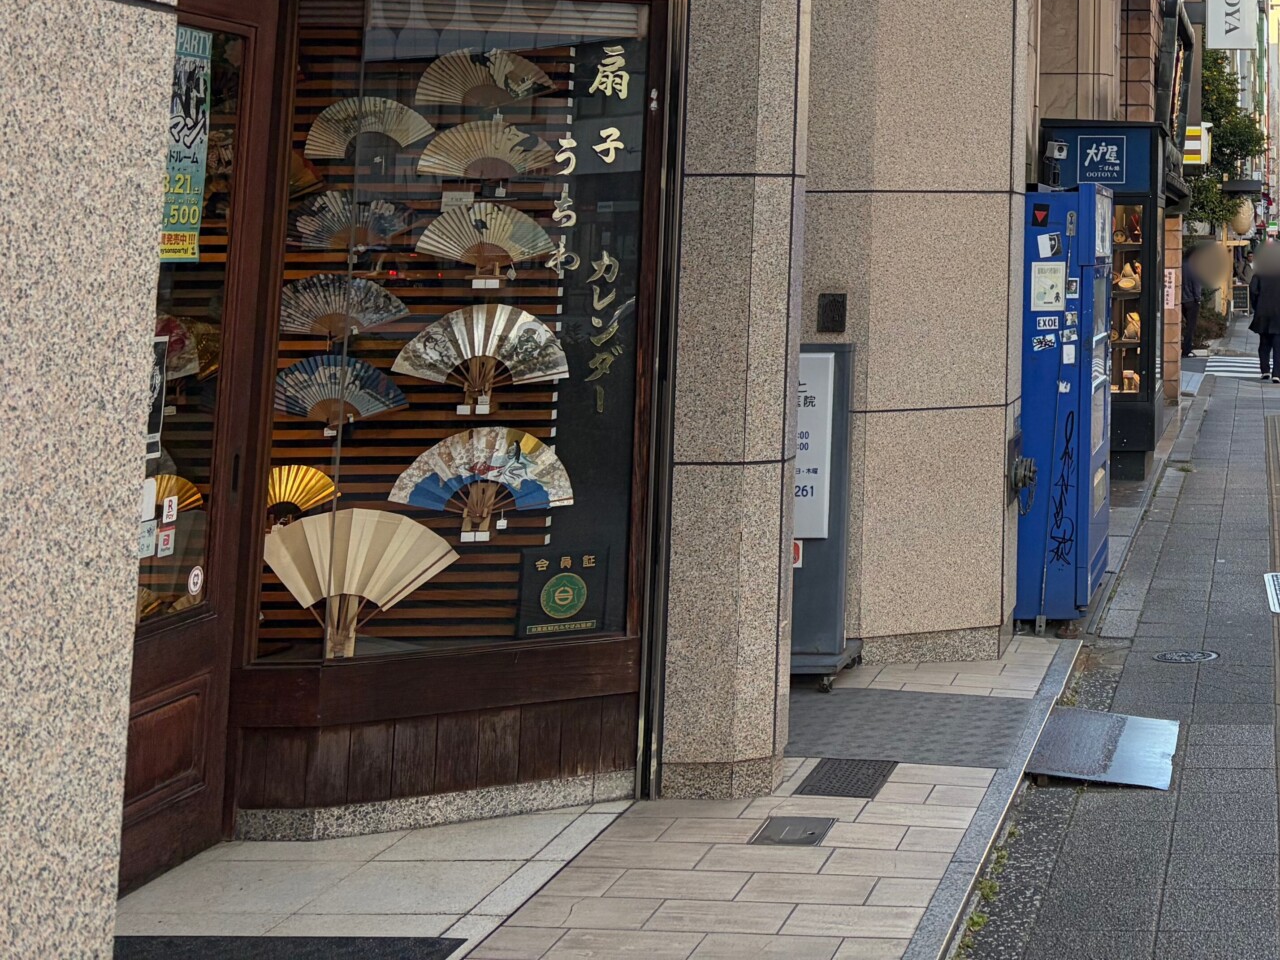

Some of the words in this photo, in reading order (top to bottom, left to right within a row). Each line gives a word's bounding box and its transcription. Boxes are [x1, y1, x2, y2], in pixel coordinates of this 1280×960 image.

[176, 28, 213, 56] PARTY
[1084, 142, 1120, 167] 大戸屋
[1037, 317, 1058, 328] EXOE
